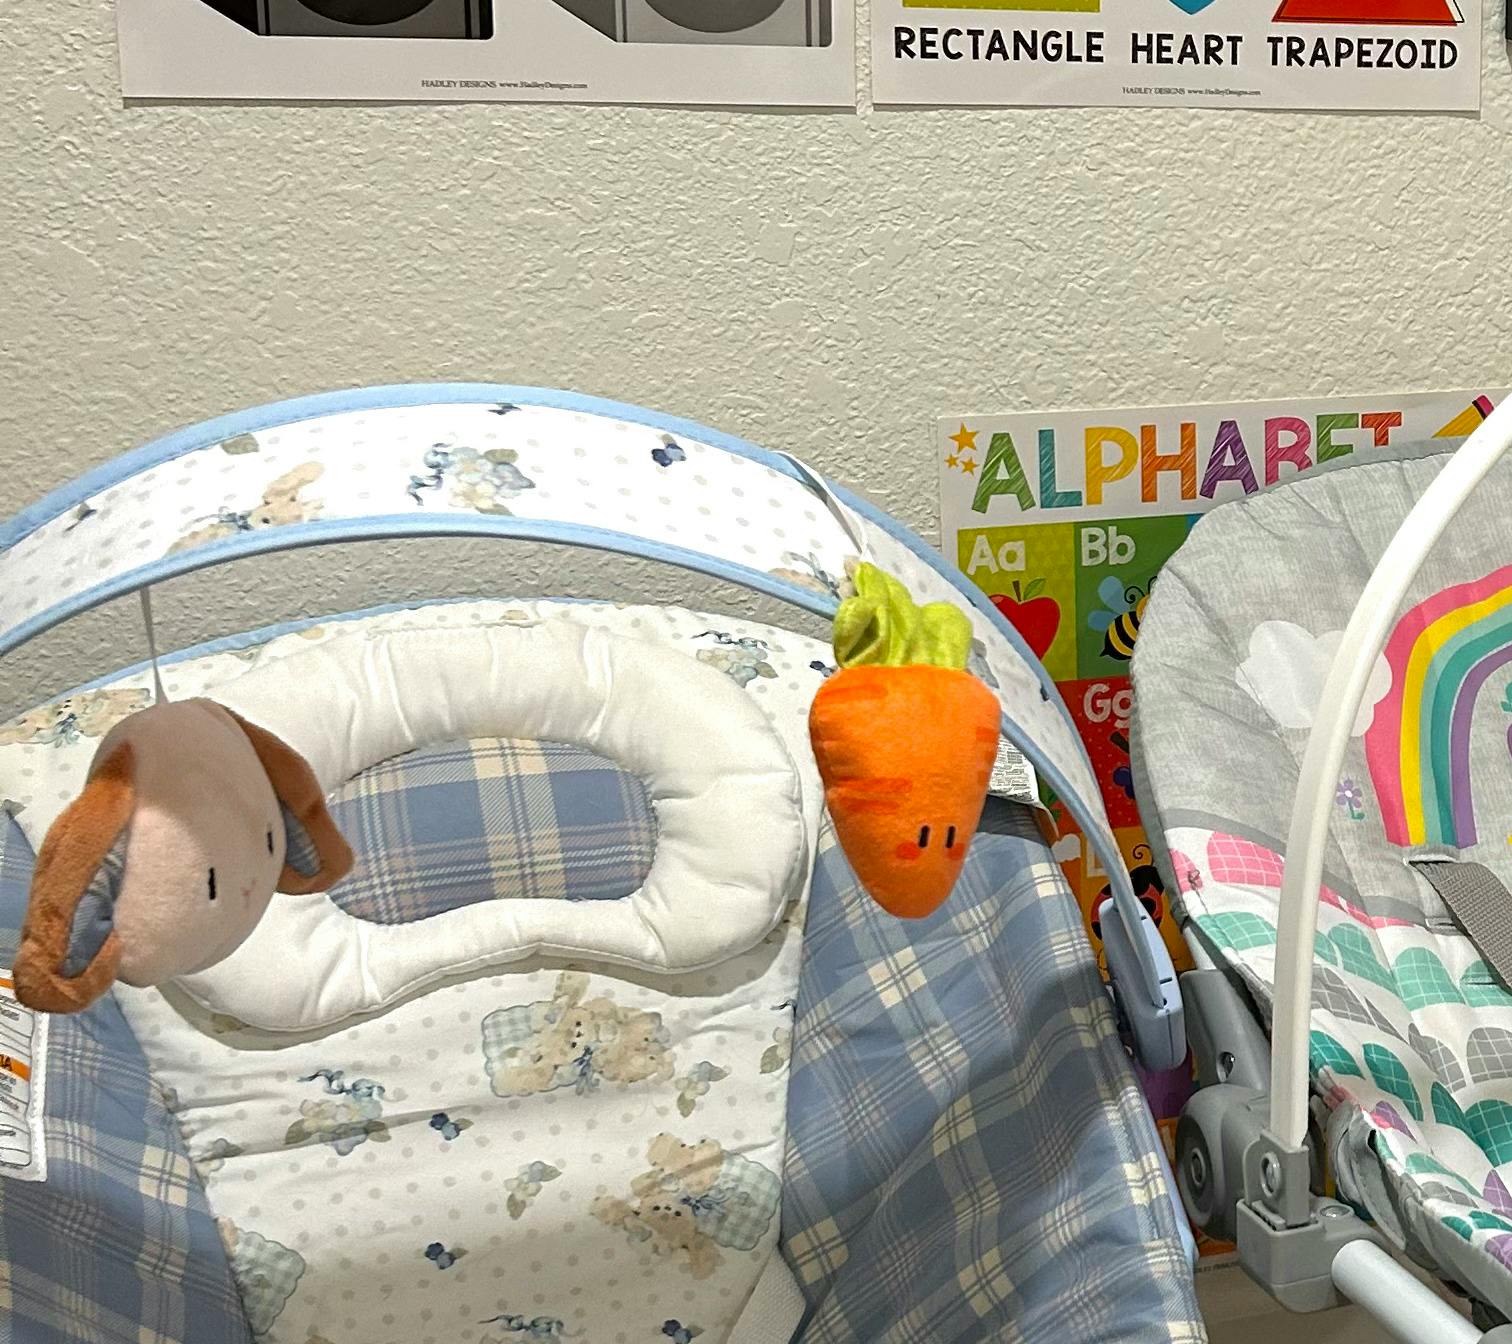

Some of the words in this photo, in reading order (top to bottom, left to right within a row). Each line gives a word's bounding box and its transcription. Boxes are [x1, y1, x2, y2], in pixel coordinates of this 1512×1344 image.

[894, 26, 1105, 64] RECTANGLE
[1130, 32, 1243, 67] HEART
[1266, 35, 1458, 70] TRAPEZOID
[421, 80, 457, 88] HADLEY
[459, 80, 497, 88] DESIGNS
[967, 535, 1026, 576] Aa
[1081, 526, 1136, 567] Bb
